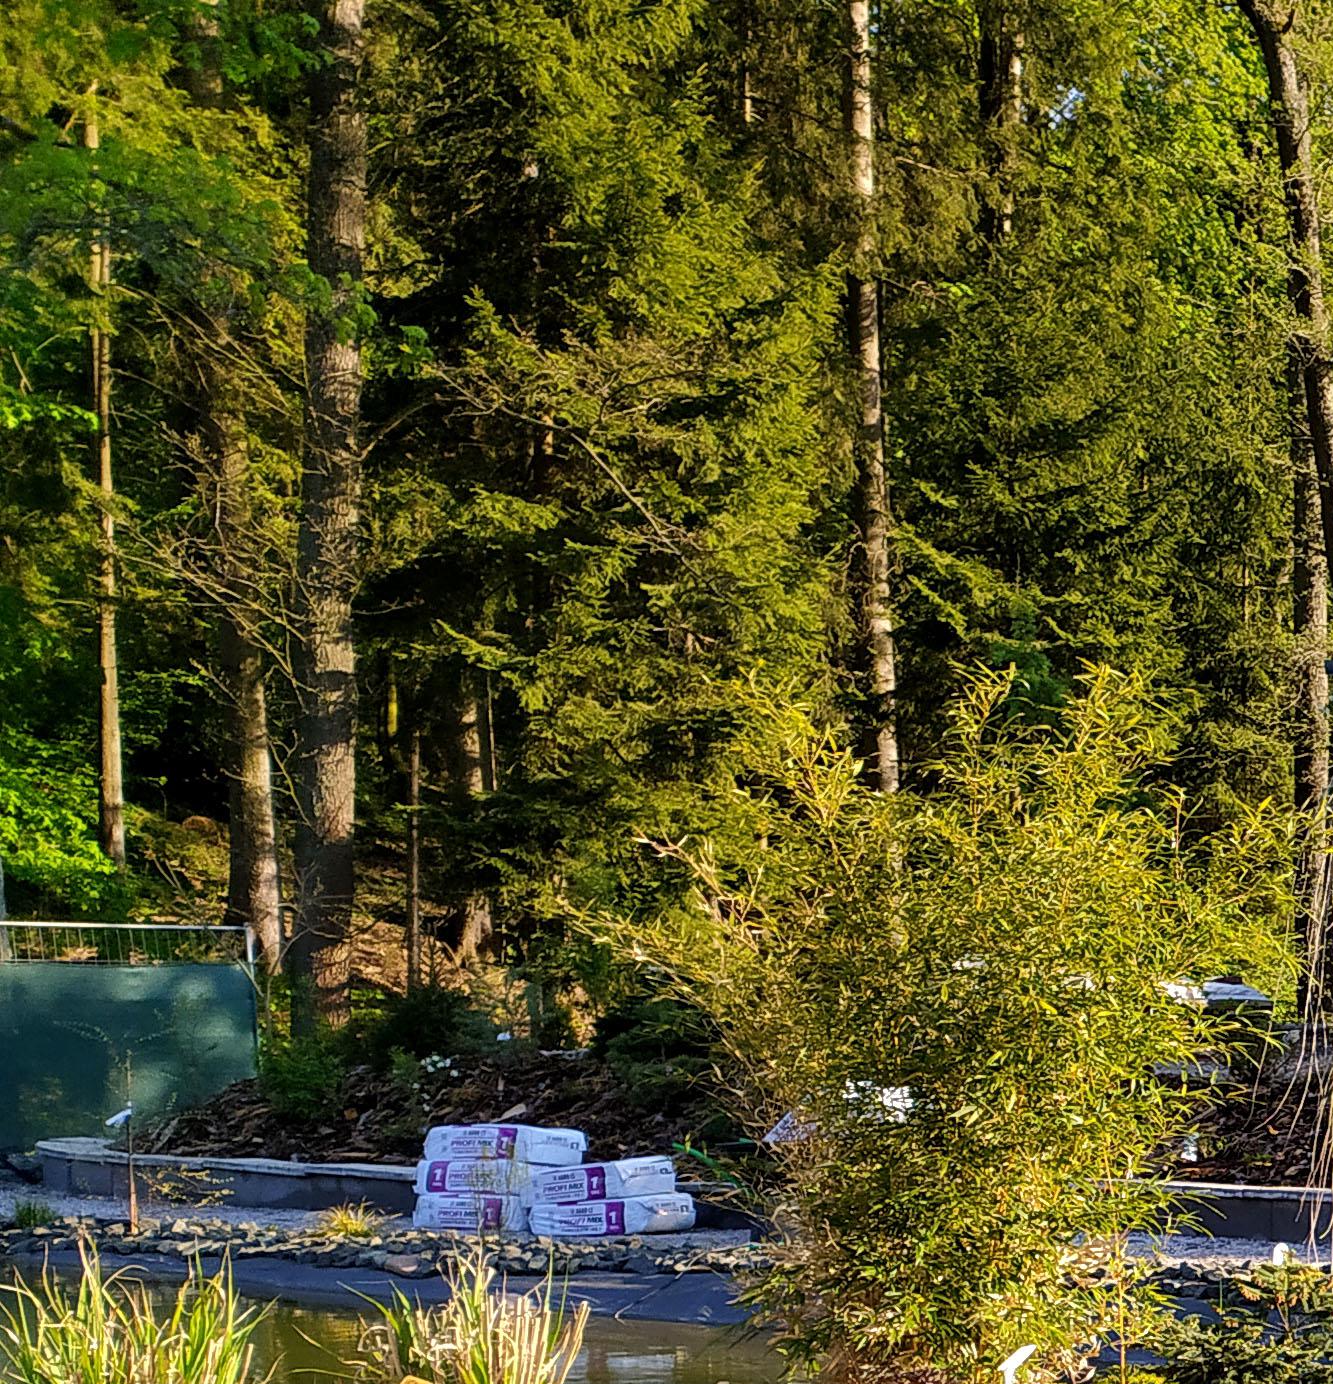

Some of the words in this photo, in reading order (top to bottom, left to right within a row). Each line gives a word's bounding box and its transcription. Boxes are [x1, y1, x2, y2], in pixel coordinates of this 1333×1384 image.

[543, 1183, 568, 1193] PROFI
[568, 1182, 584, 1191] MIX
[587, 1216, 603, 1225] MIX
